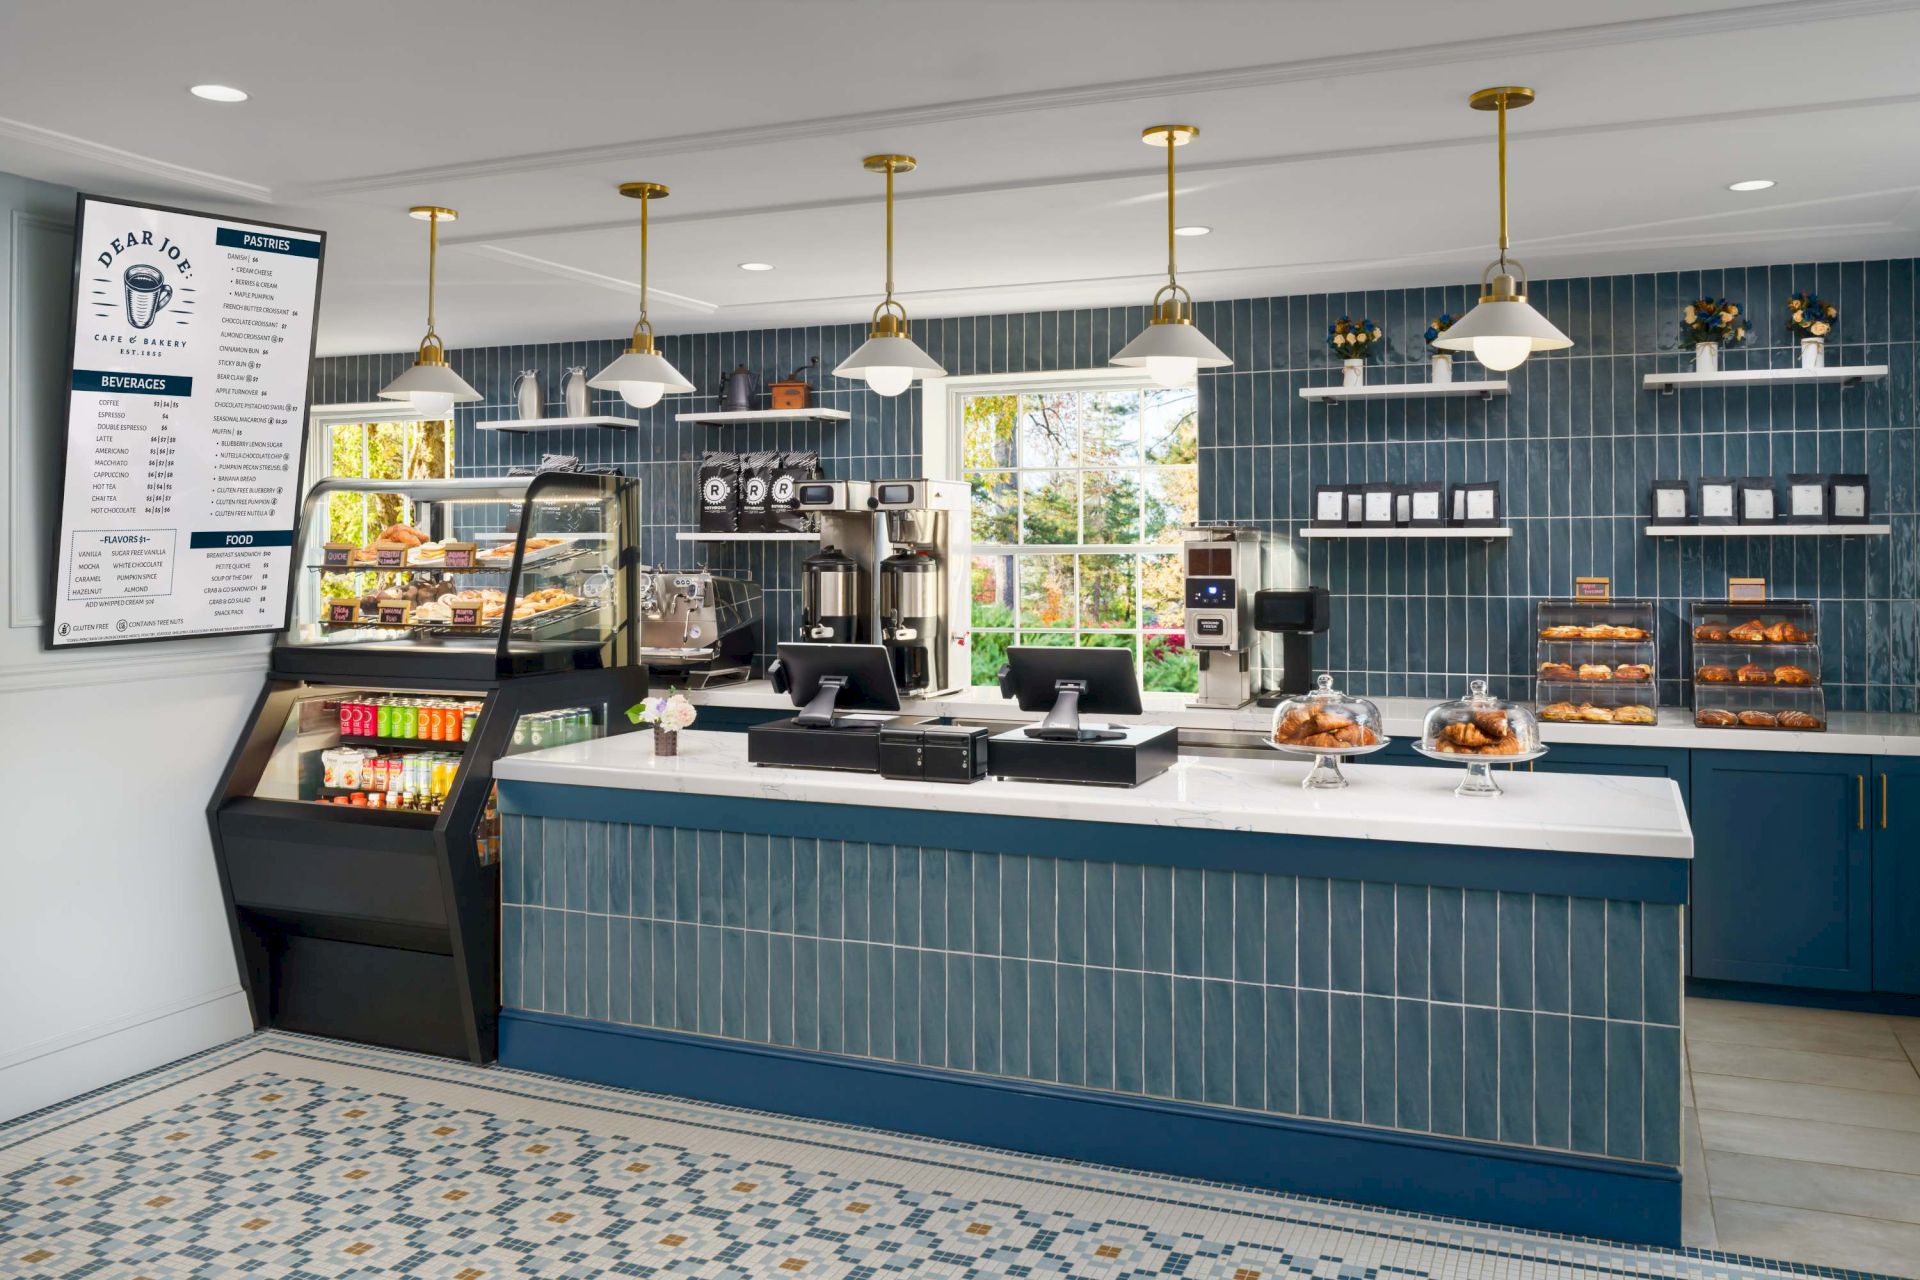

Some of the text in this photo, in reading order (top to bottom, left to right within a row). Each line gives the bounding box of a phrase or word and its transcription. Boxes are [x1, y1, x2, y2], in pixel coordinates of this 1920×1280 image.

[244, 235, 289, 250] PASTRIES
[98, 230, 153, 268] DEAR
[94, 334, 122, 342] CAFE
[144, 338, 187, 348] BAKERY
[102, 377, 165, 389] BEVERAGES
[710, 484, 718, 496] R
[750, 485, 758, 496] R
[779, 483, 788, 494] R
[226, 535, 253, 544] FOOD
